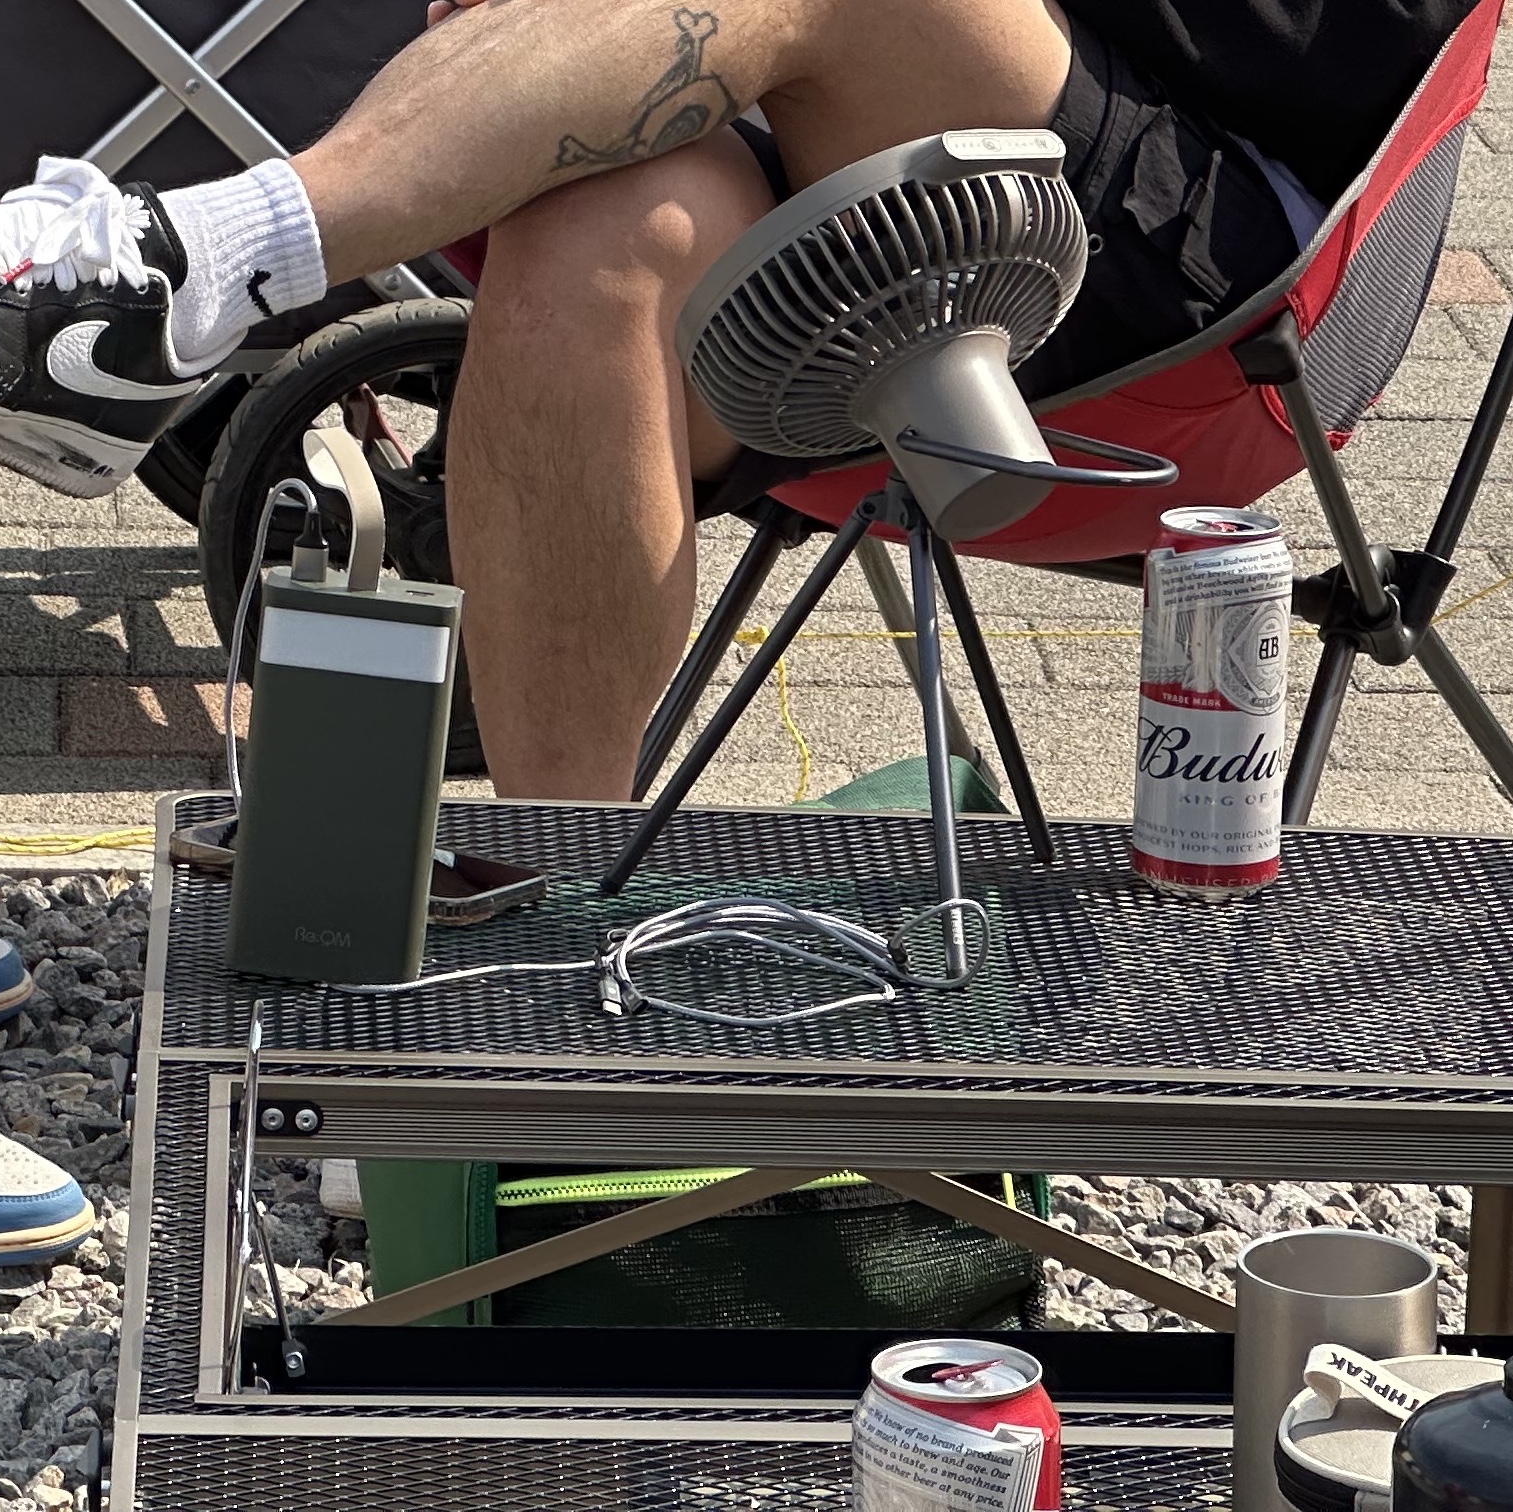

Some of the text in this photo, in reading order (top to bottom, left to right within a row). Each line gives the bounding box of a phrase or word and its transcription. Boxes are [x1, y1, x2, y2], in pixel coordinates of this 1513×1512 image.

[1162, 693, 1221, 707] TRADE MARK
[1180, 793, 1234, 807] KING
[1245, 792, 1267, 805] OF
[1171, 828, 1185, 837] BY
[1190, 831, 1221, 841] OUR
[1226, 844, 1253, 854] RICE
[1326, 1351, 1420, 1413] THPEAK
[899, 1439, 910, 1450] to
[912, 1443, 941, 1460] brew
[941, 1455, 965, 1468] and
[990, 1467, 1011, 1481] Our
[904, 1427, 918, 1438] of
[916, 1431, 929, 1442] no
[931, 1434, 964, 1453] brand
[964, 1447, 1014, 1467] produced
[885, 1463, 912, 1479] other
[913, 1471, 938, 1488] beer
[939, 1484, 951, 1493] at
[953, 1488, 976, 1502] any
[975, 1494, 1005, 1508] price.
[899, 1453, 928, 1472] taste,
[940, 1469, 1007, 1494] smoothness
